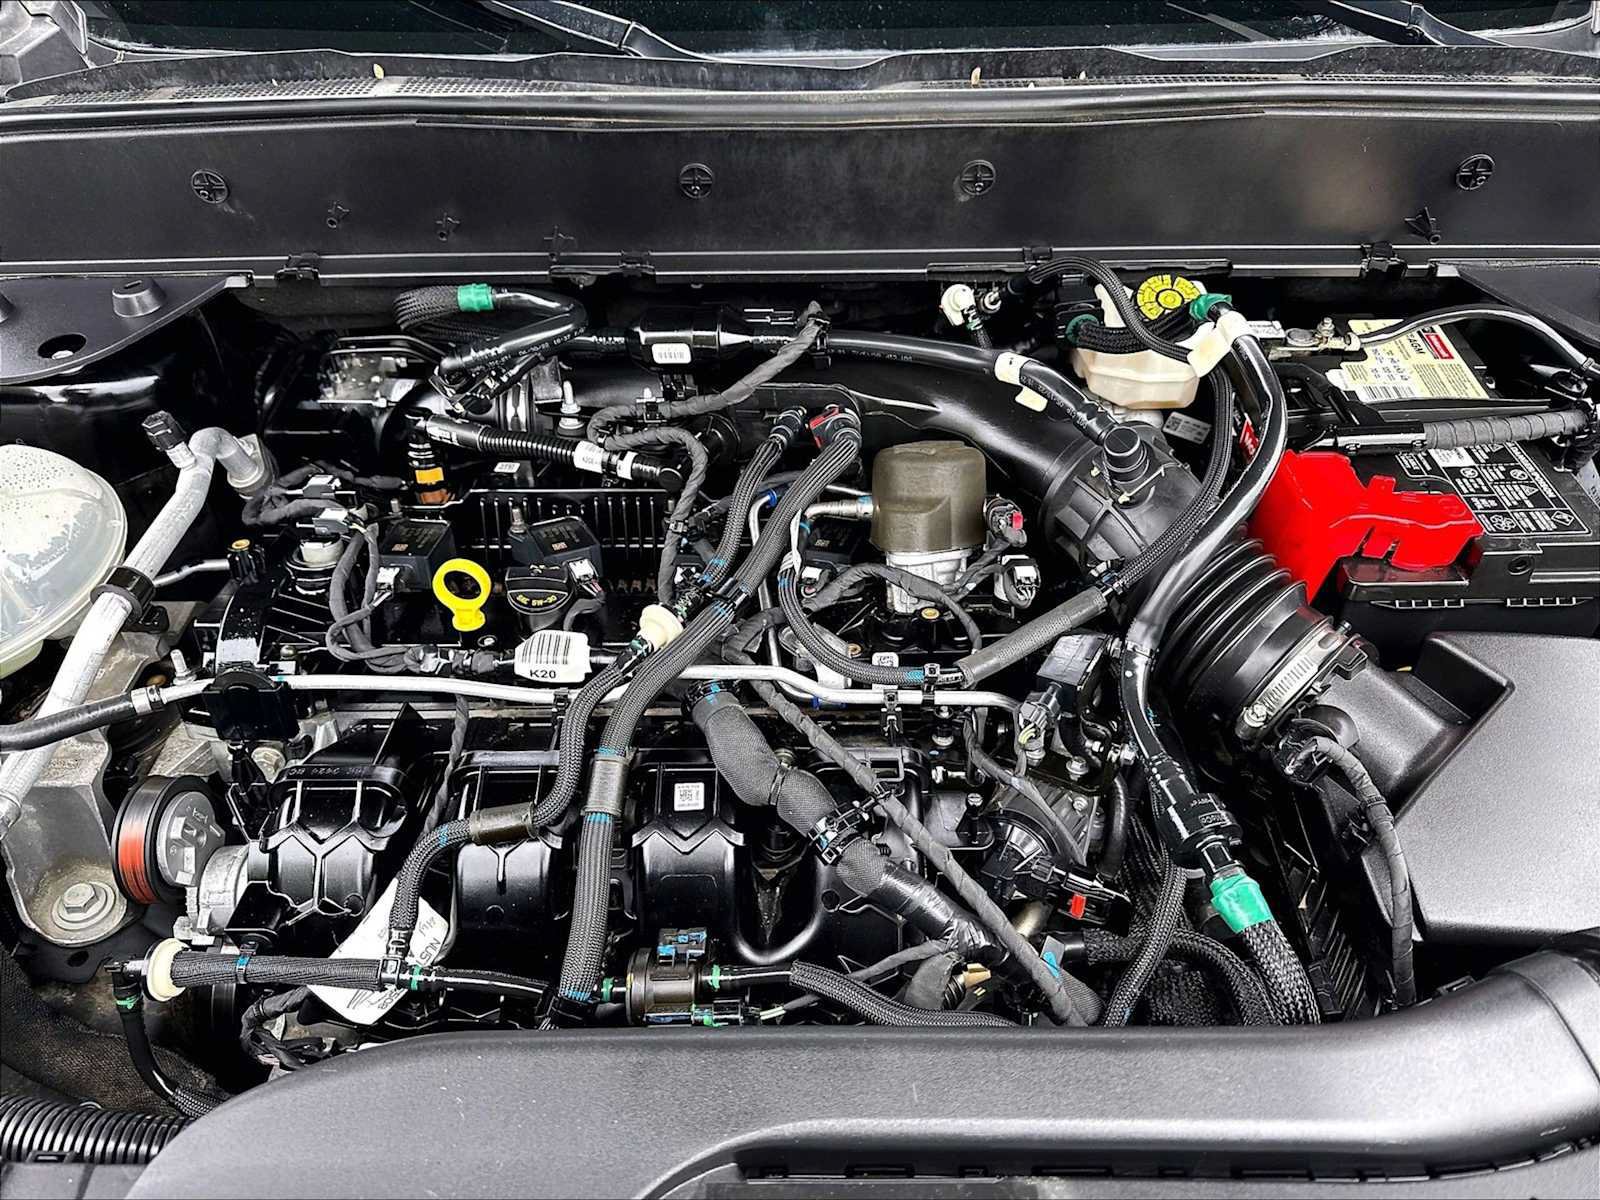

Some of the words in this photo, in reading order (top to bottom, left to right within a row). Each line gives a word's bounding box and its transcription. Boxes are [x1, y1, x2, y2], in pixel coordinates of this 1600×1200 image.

[1408, 336, 1426, 354] AGM
[531, 594, 558, 607] 5W-30
[529, 669, 557, 679] K20
